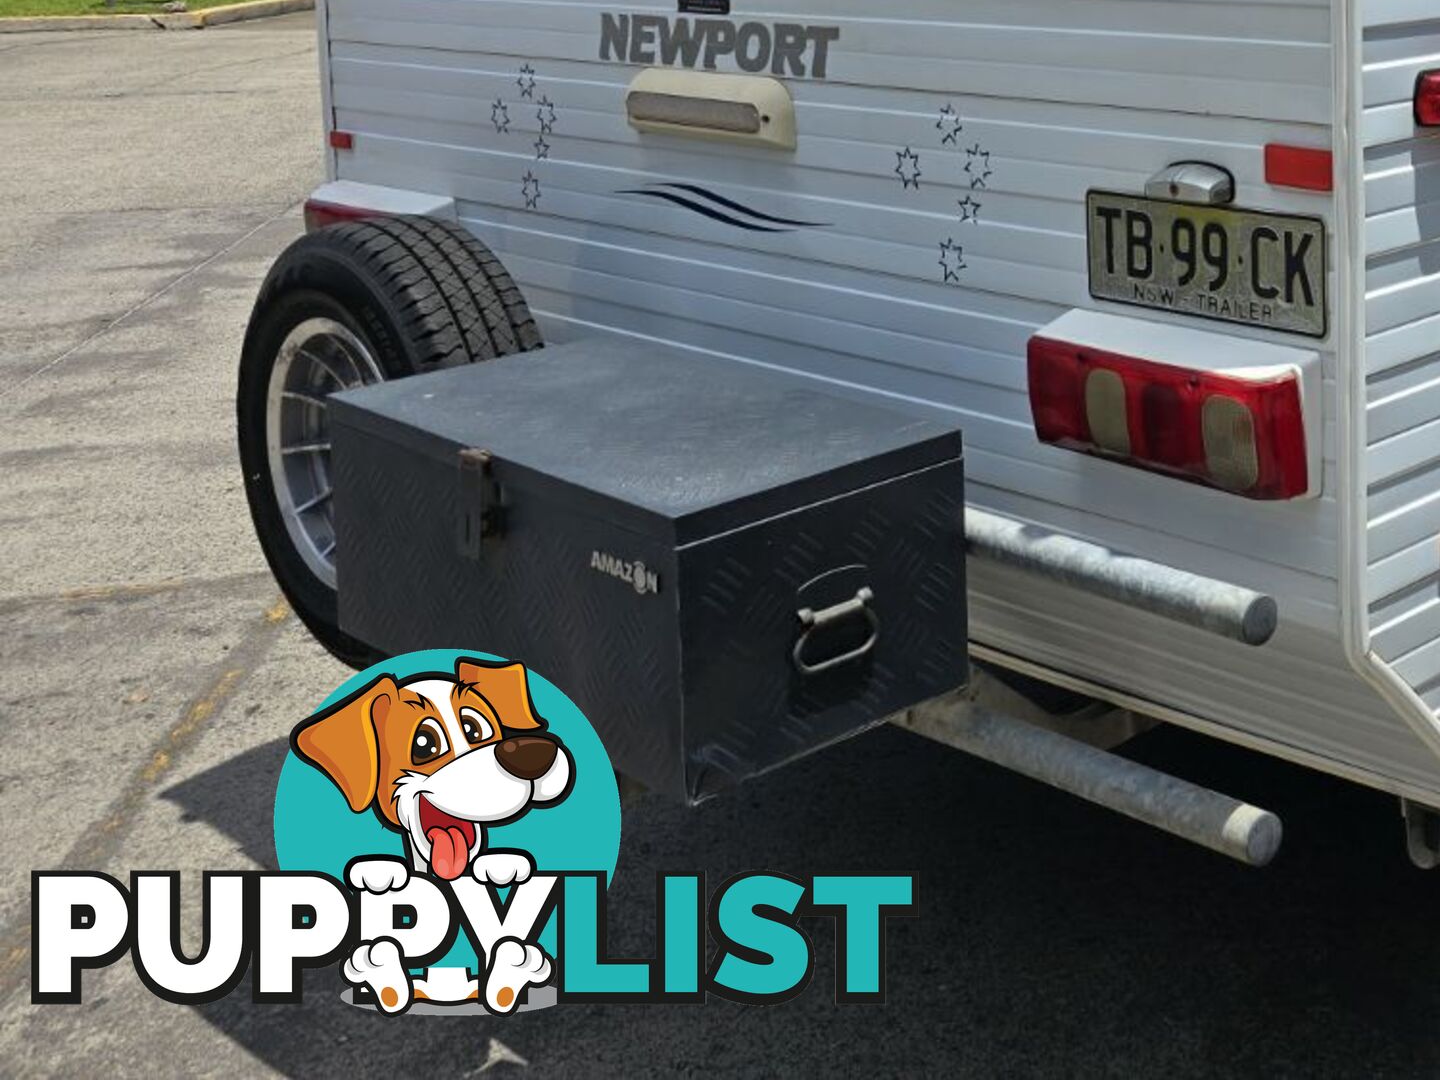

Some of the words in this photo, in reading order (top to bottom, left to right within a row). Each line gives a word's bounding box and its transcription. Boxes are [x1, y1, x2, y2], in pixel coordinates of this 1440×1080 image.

[599, 12, 839, 78] NEWPORT
[1134, 283, 1174, 306] NSW
[1198, 294, 1272, 319] TRAILER
